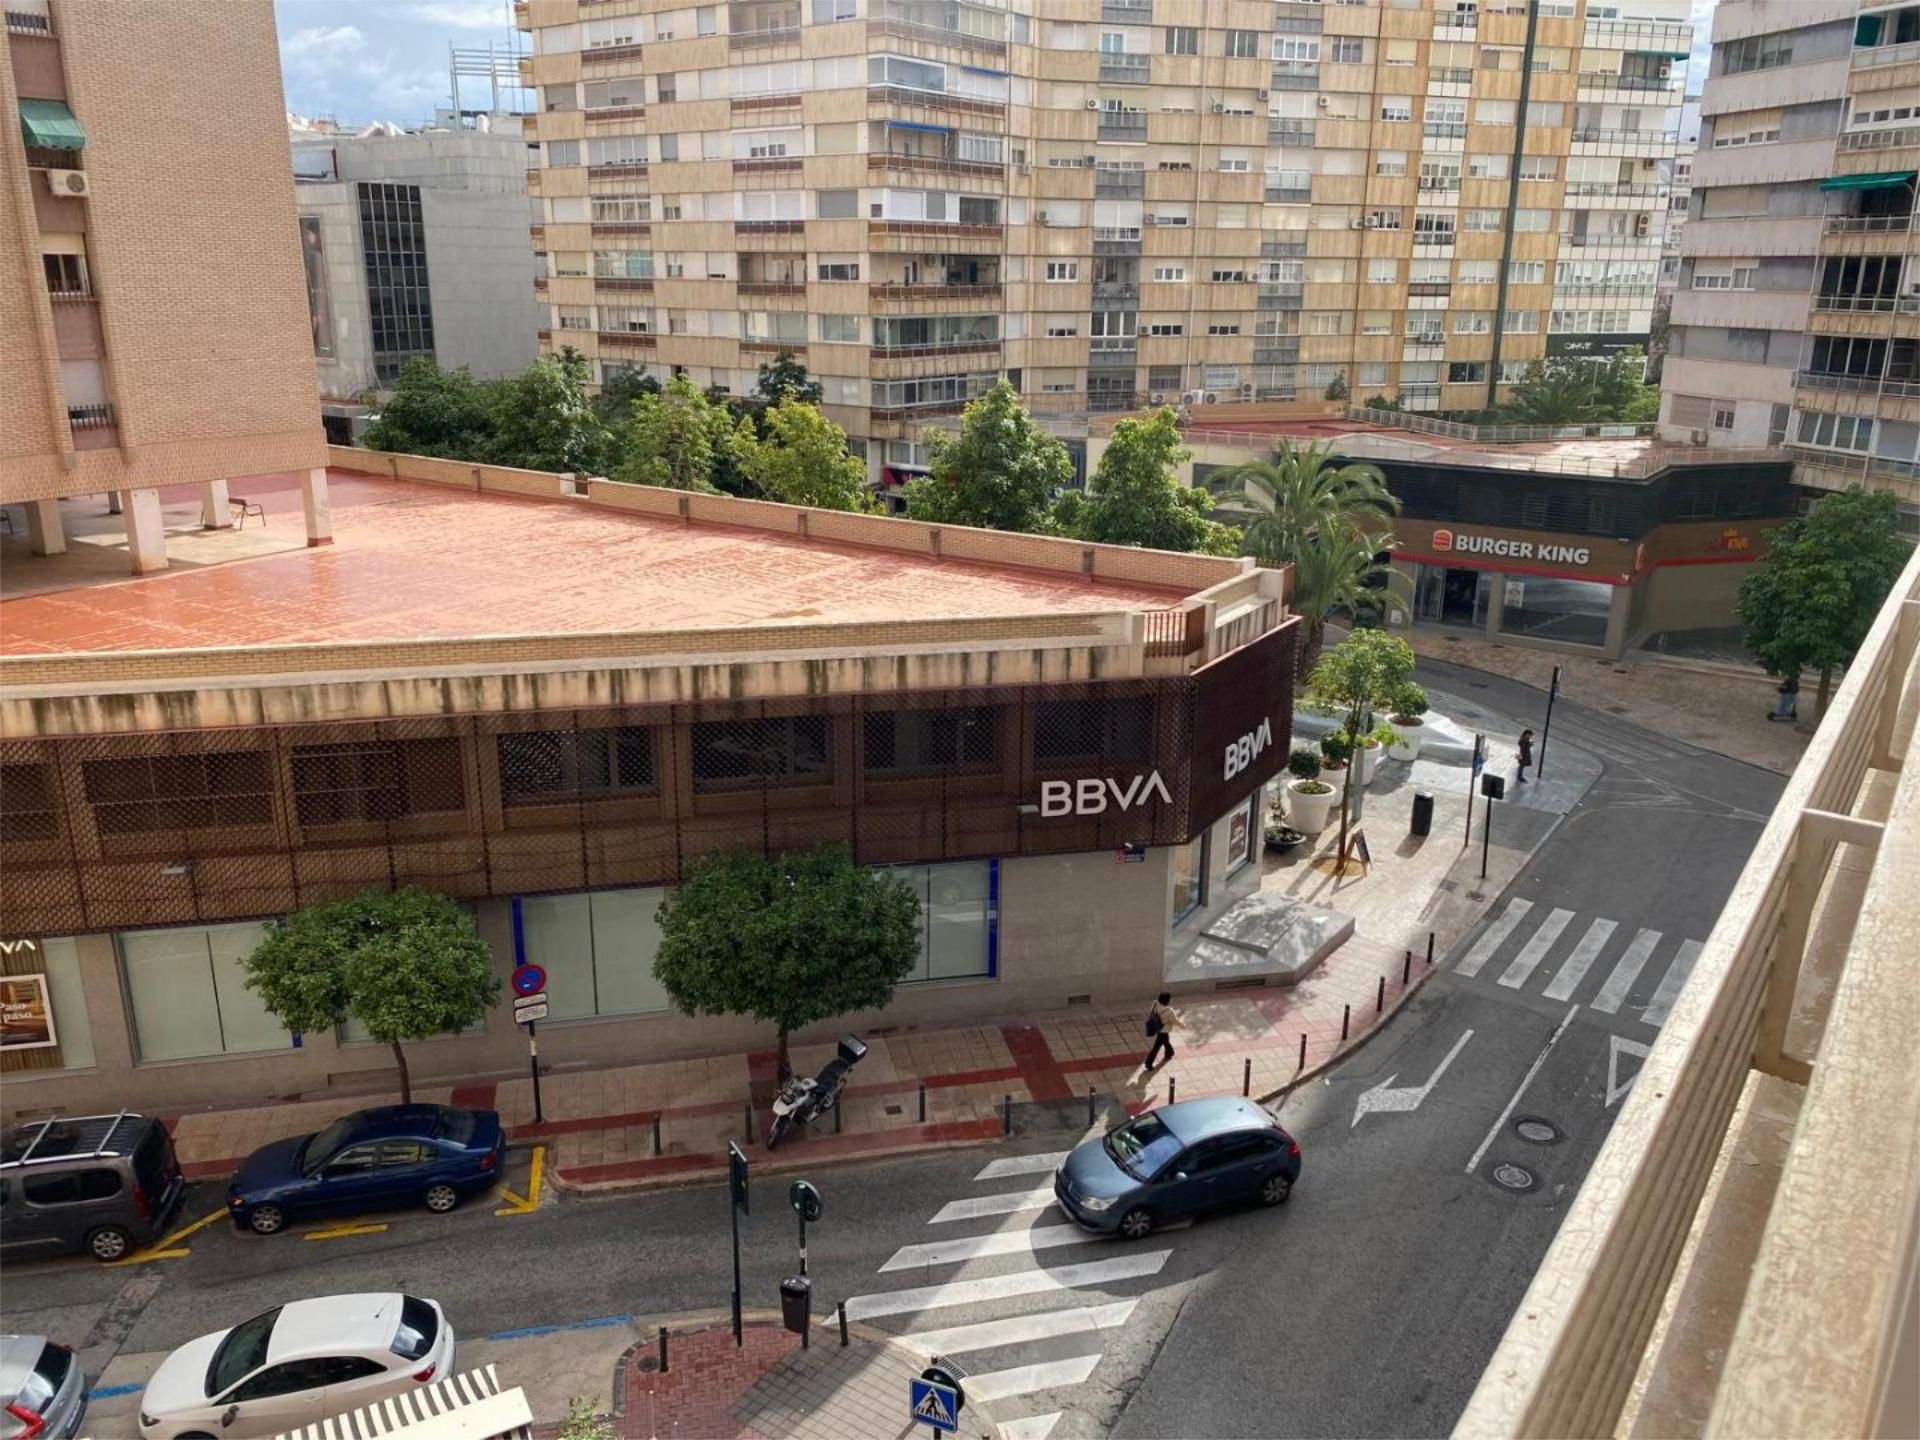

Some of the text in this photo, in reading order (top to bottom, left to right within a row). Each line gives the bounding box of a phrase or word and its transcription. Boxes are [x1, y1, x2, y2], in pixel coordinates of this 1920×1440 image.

[1455, 535, 1533, 558] BURGER
[1538, 544, 1590, 564] KING
[1223, 716, 1273, 781] BBVA
[1041, 769, 1173, 817] BBVA
